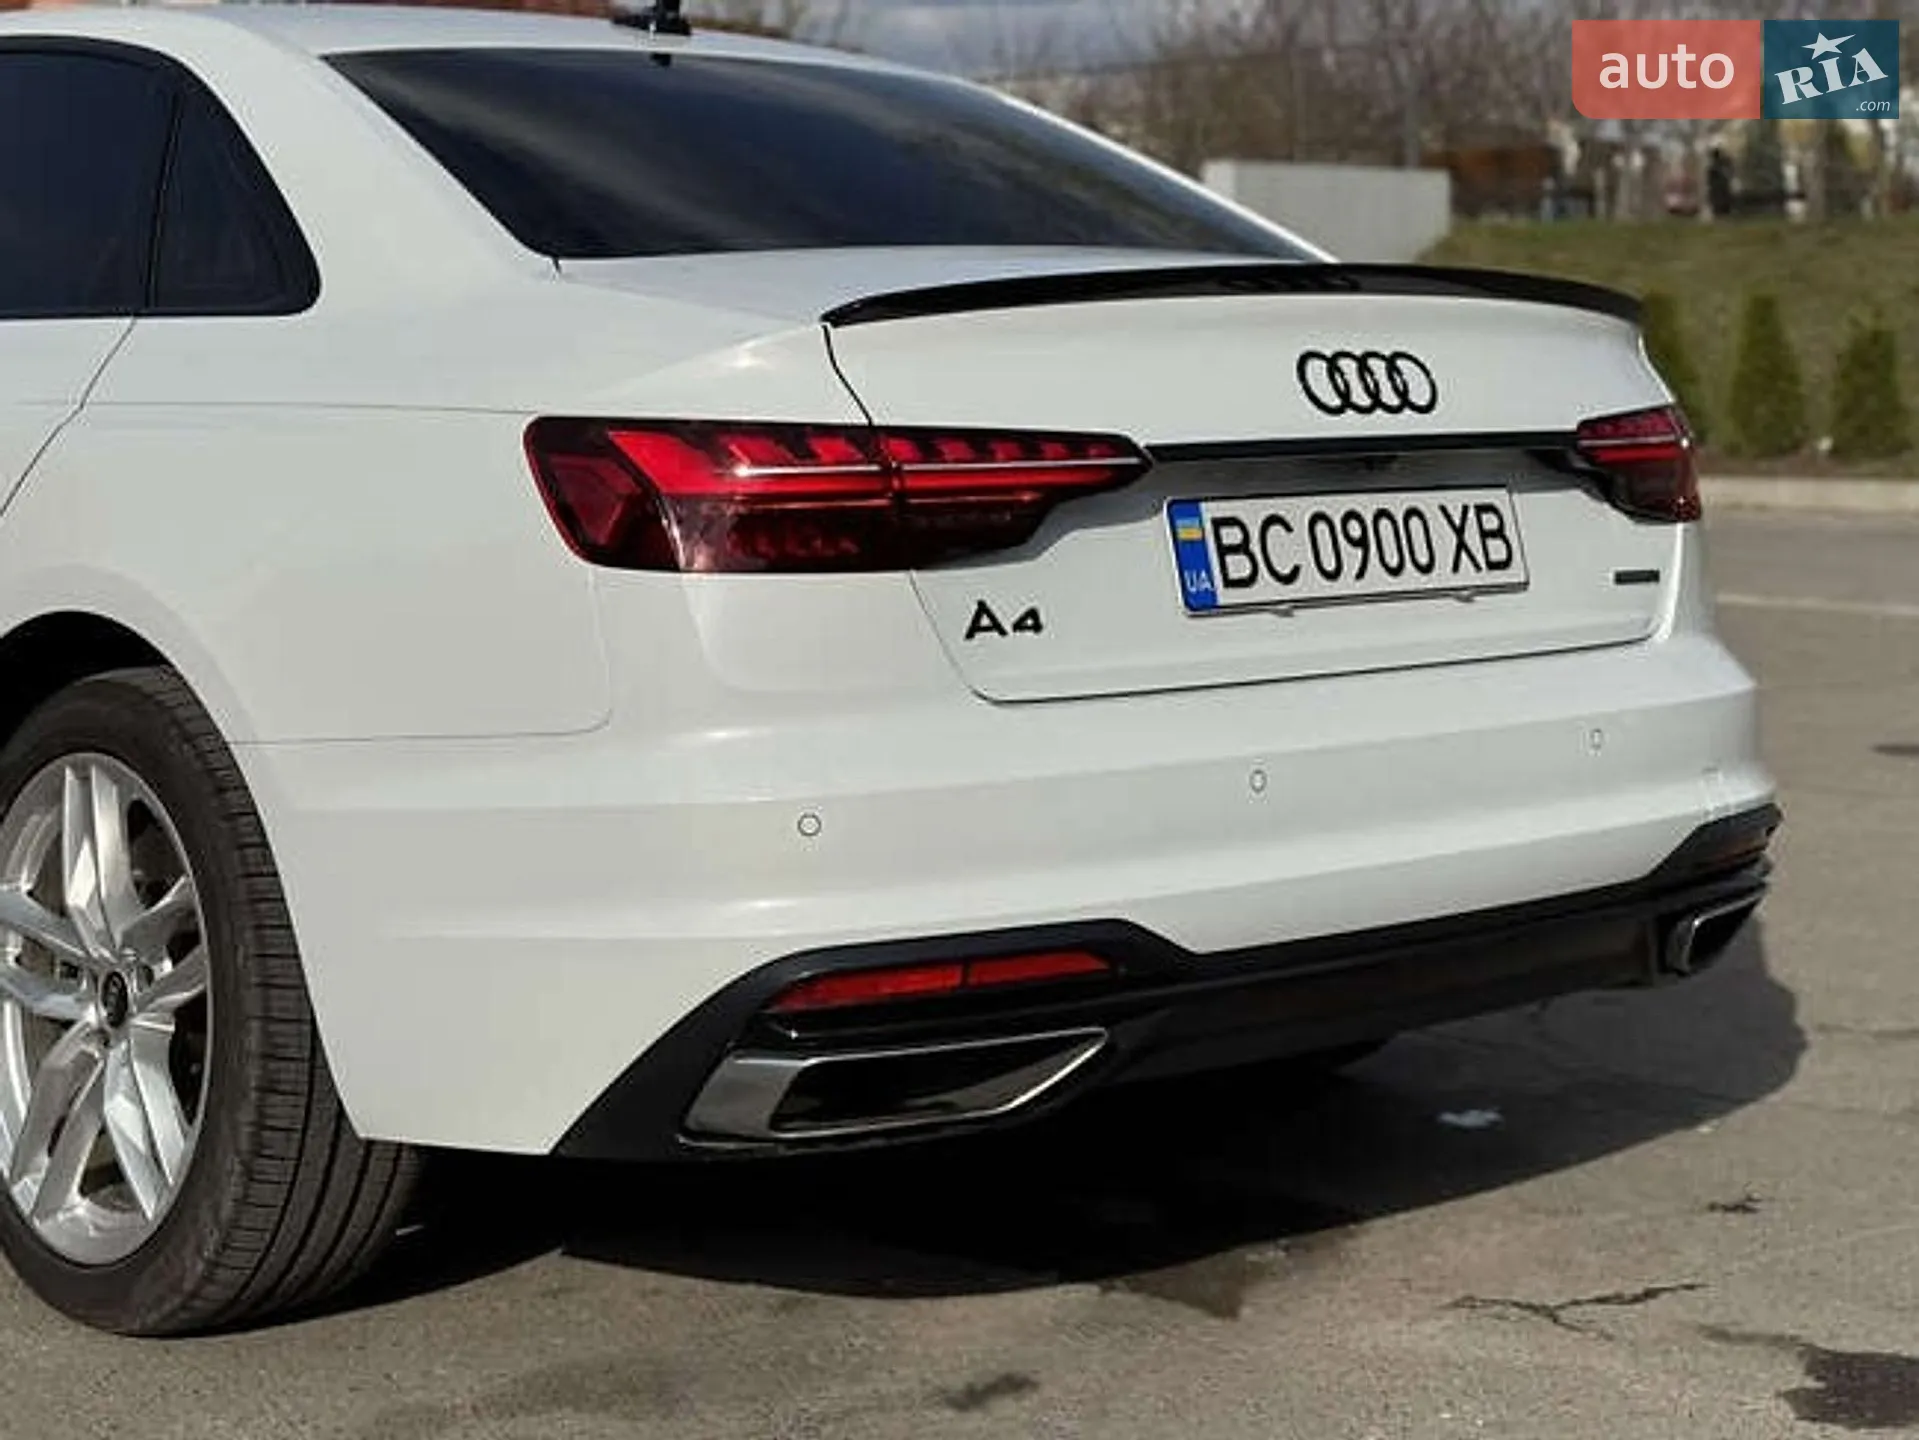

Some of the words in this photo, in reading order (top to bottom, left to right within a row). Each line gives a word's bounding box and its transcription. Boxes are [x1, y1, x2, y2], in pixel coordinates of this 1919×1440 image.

[1211, 514, 1301, 589] BC
[1308, 506, 1436, 582] 0900
[1438, 502, 1513, 574] XB
[1184, 568, 1215, 593] UA
[964, 598, 1044, 640] A4
